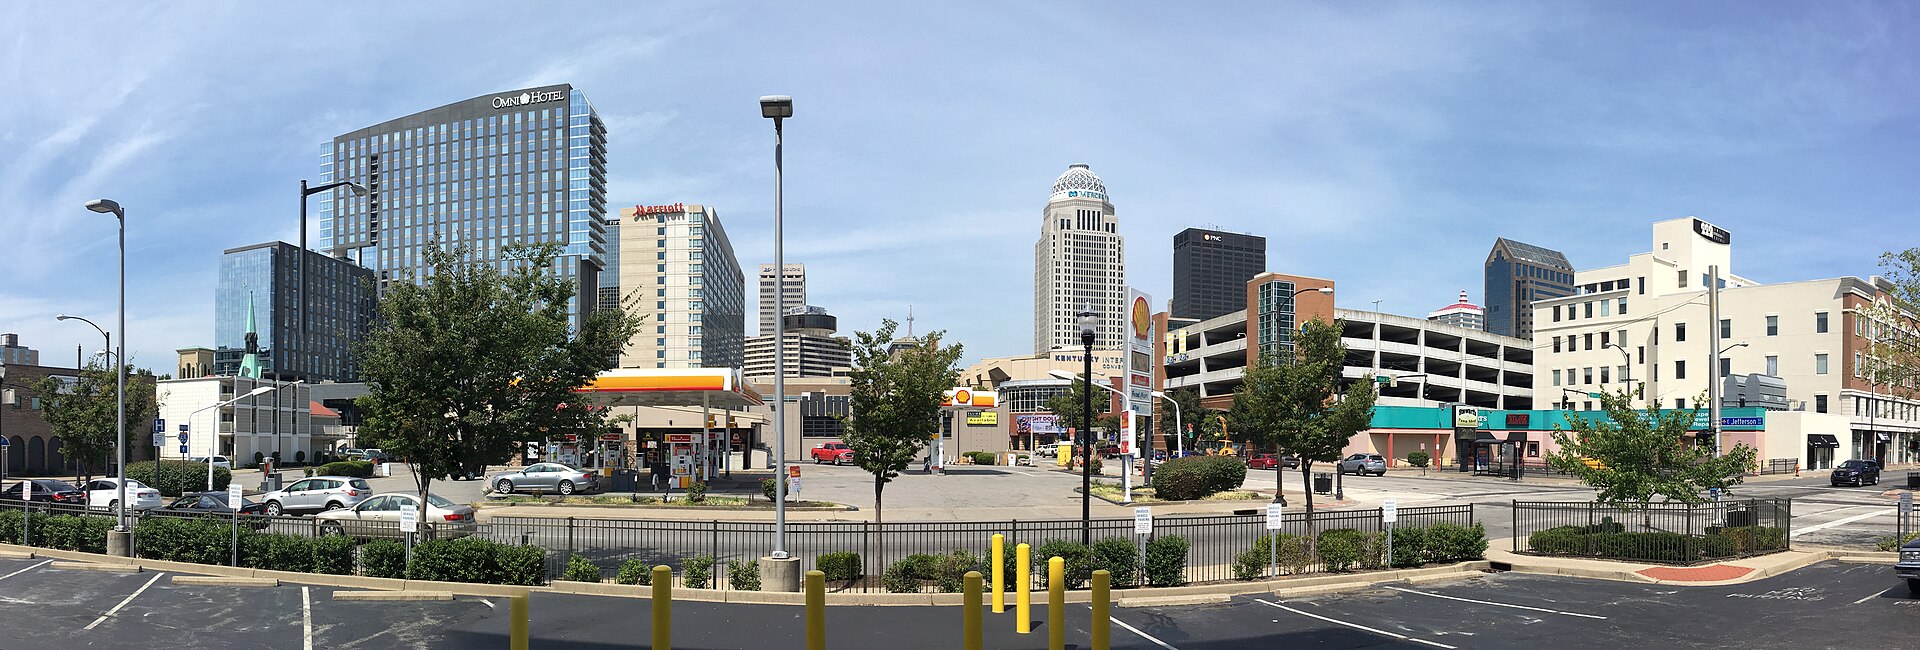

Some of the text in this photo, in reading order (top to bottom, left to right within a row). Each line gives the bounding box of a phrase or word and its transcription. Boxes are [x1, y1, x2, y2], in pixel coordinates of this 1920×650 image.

[492, 91, 565, 108] OMNI HOTEL
[632, 202, 684, 217] Marriott
[1055, 354, 1099, 362] KENTUKY
